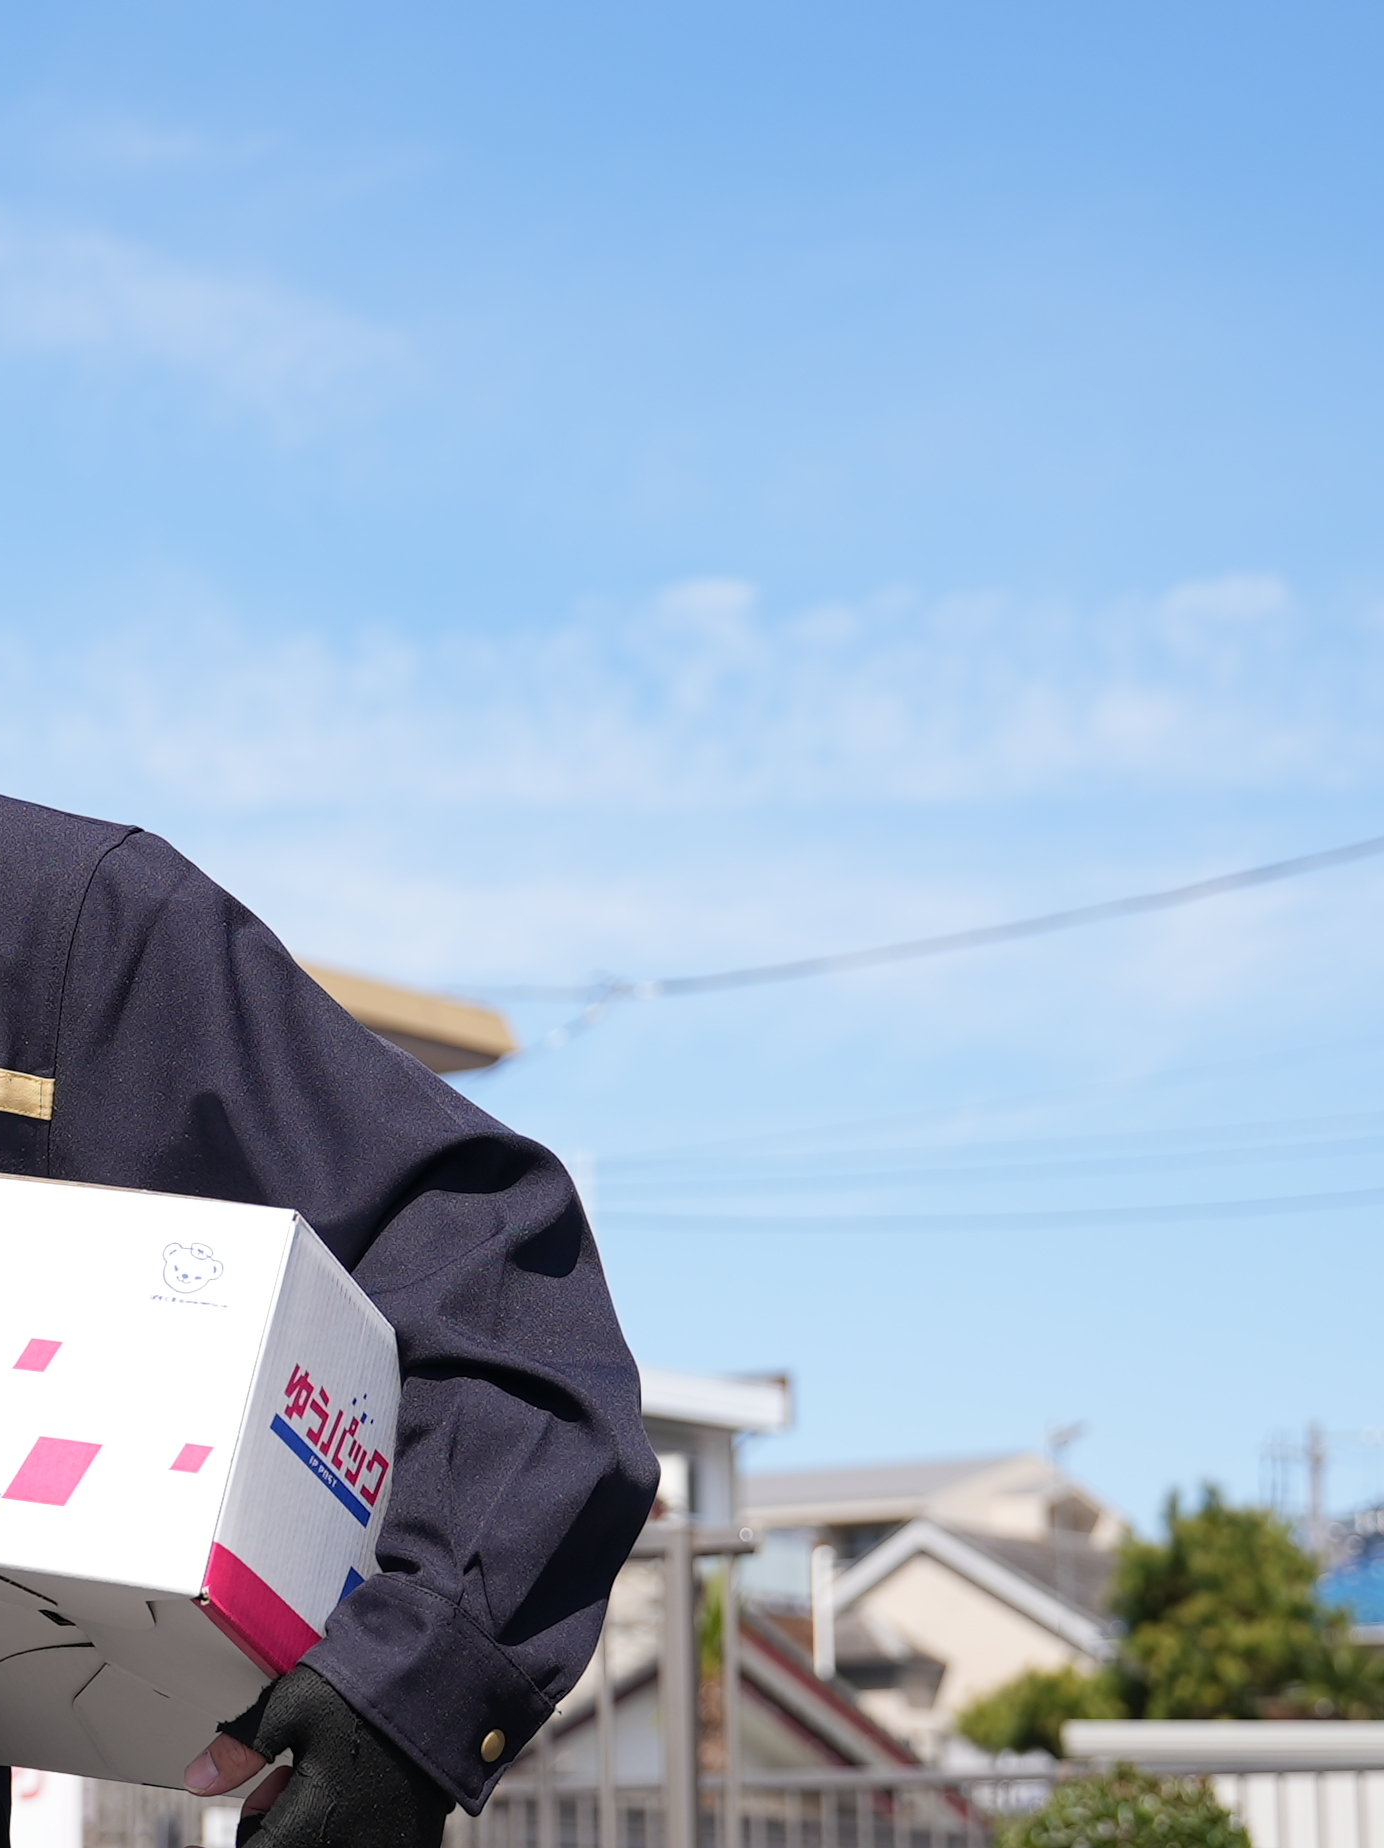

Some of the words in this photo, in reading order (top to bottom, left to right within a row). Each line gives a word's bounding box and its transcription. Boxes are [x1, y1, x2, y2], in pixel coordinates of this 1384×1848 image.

[283, 1363, 390, 1508] ゆうパック
